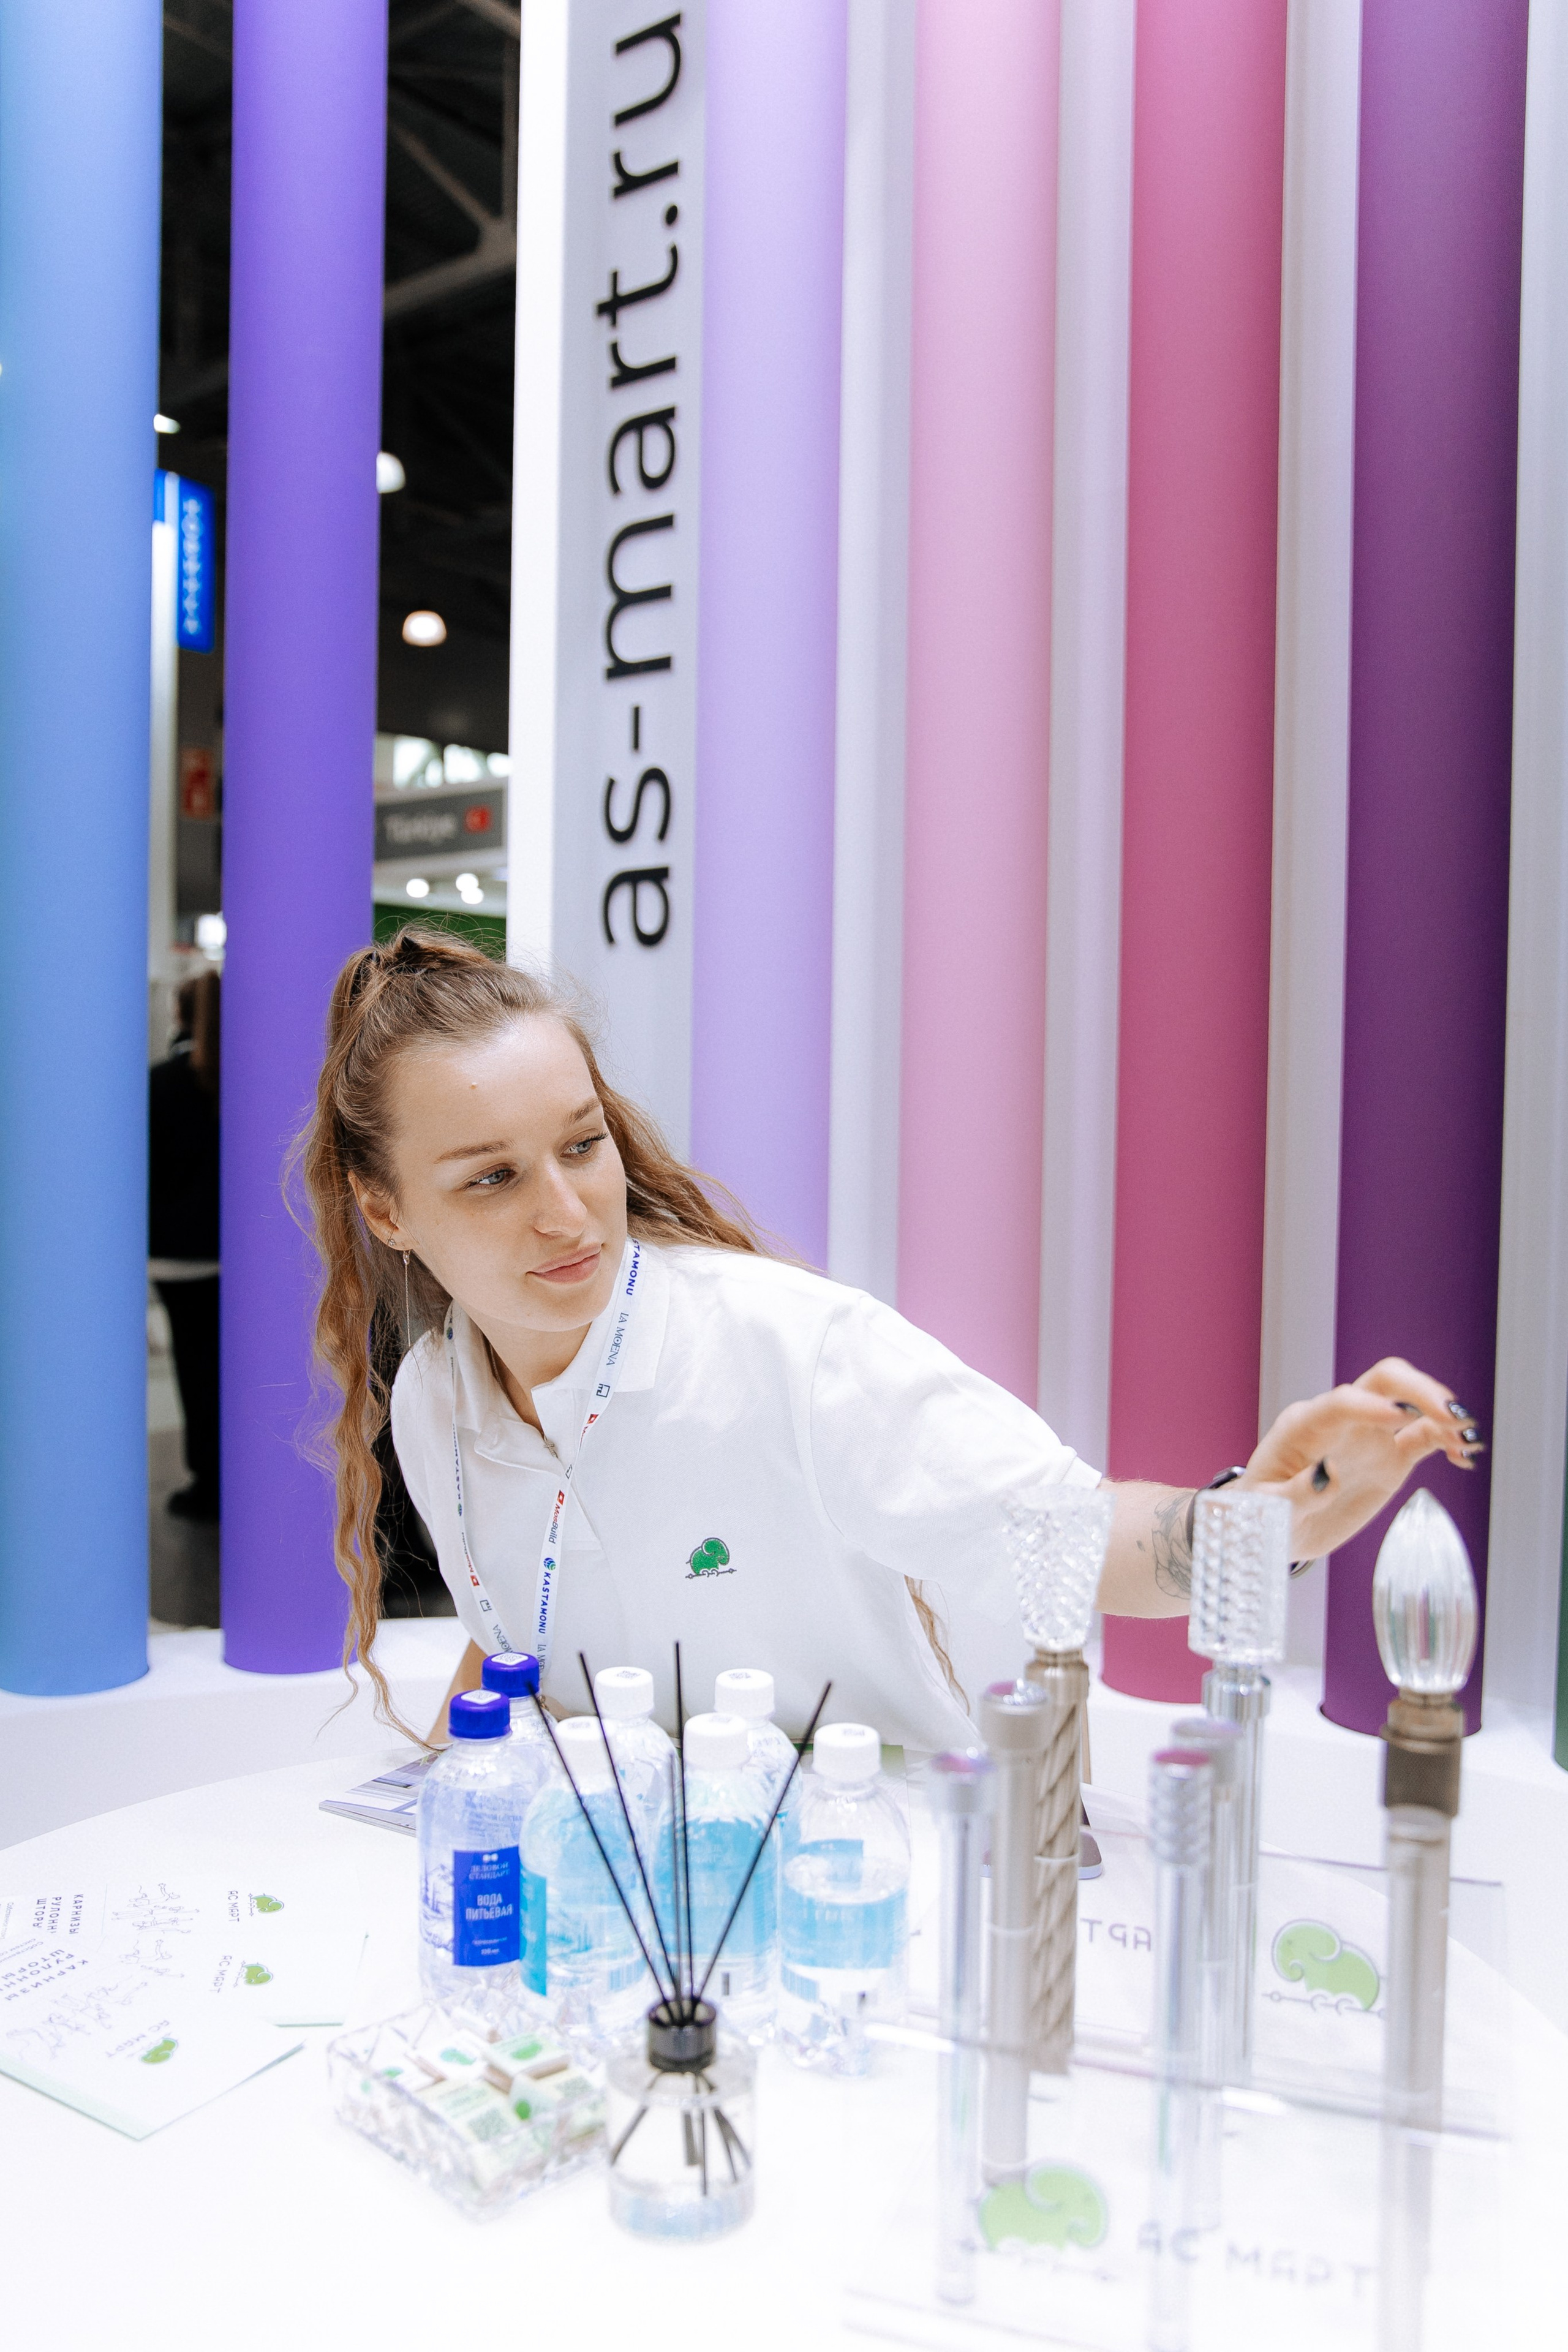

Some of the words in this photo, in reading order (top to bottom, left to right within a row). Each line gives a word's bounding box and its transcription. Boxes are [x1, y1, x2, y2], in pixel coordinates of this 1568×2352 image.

[595, 13, 682, 949] as-mart.ru
[626, 1238, 641, 1295] STAMONU
[618, 1312, 629, 1323] LA
[606, 1327, 625, 1366] MOENA
[548, 1504, 560, 1544] MosBuild
[538, 1572, 551, 1634] KASTAMONU
[47, 1896, 62, 1933] РУЛОНН
[69, 1894, 83, 1934] КАРНИЗЫ
[466, 1904, 513, 1920] ПИТЬЕВАЯ
[477, 1893, 502, 1906] ВОДА
[0, 1953, 74, 1991] РУЛОНН
[1, 1949, 65, 1980] ШТОРЫ
[5, 1959, 88, 2000] КАРНИЗЫ
